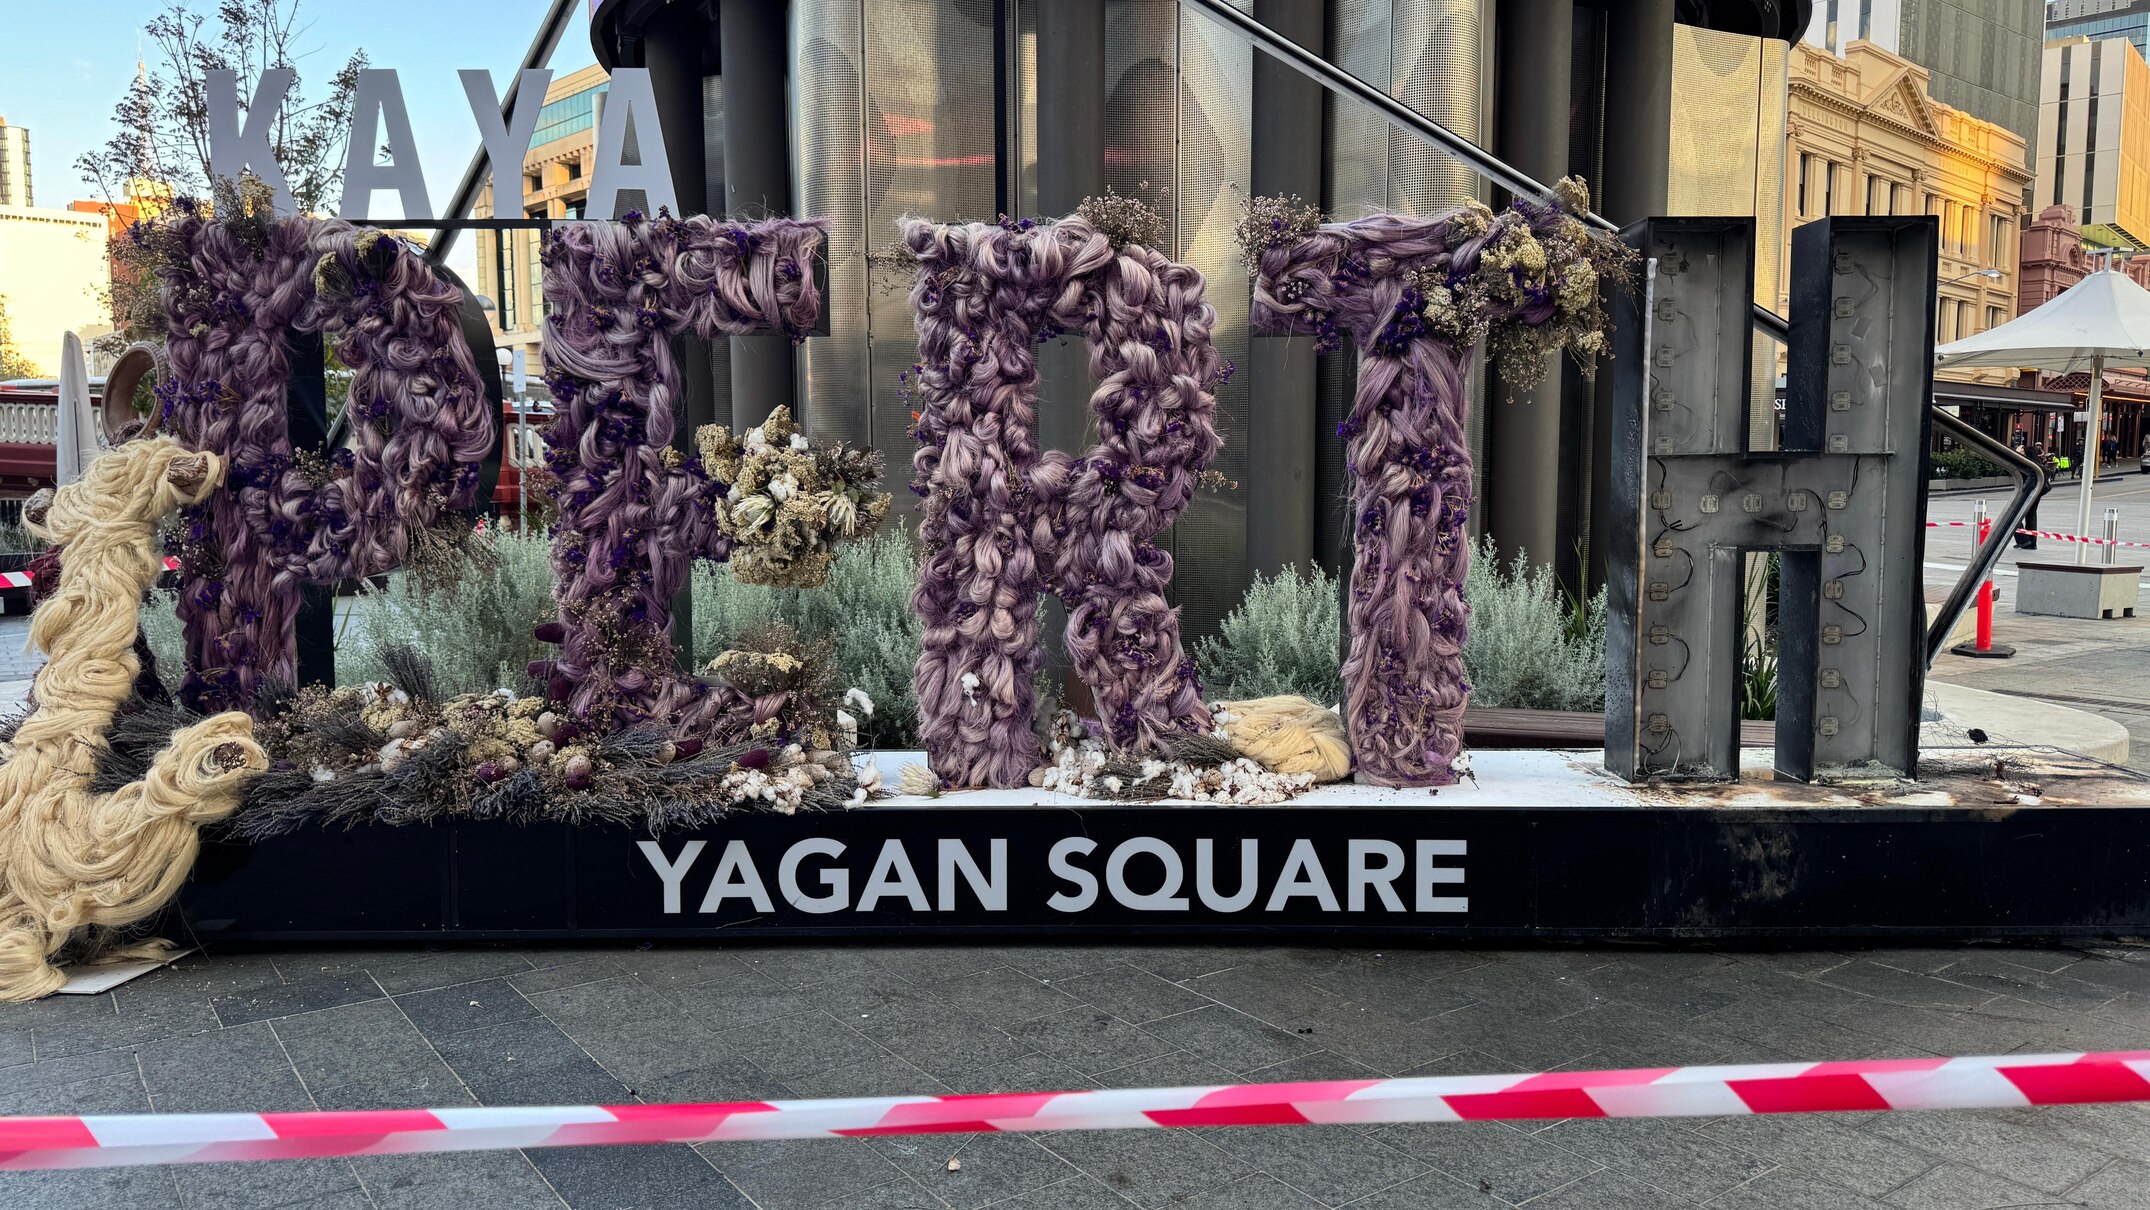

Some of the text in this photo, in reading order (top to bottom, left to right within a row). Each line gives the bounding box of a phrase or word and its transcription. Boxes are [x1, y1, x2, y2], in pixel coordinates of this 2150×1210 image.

[205, 68, 680, 220] KAYA
[1802, 104, 1848, 132] WELLINGTON
[160, 212, 1940, 791] PERTH
[636, 836, 1469, 914] YAGAN SQUARE
